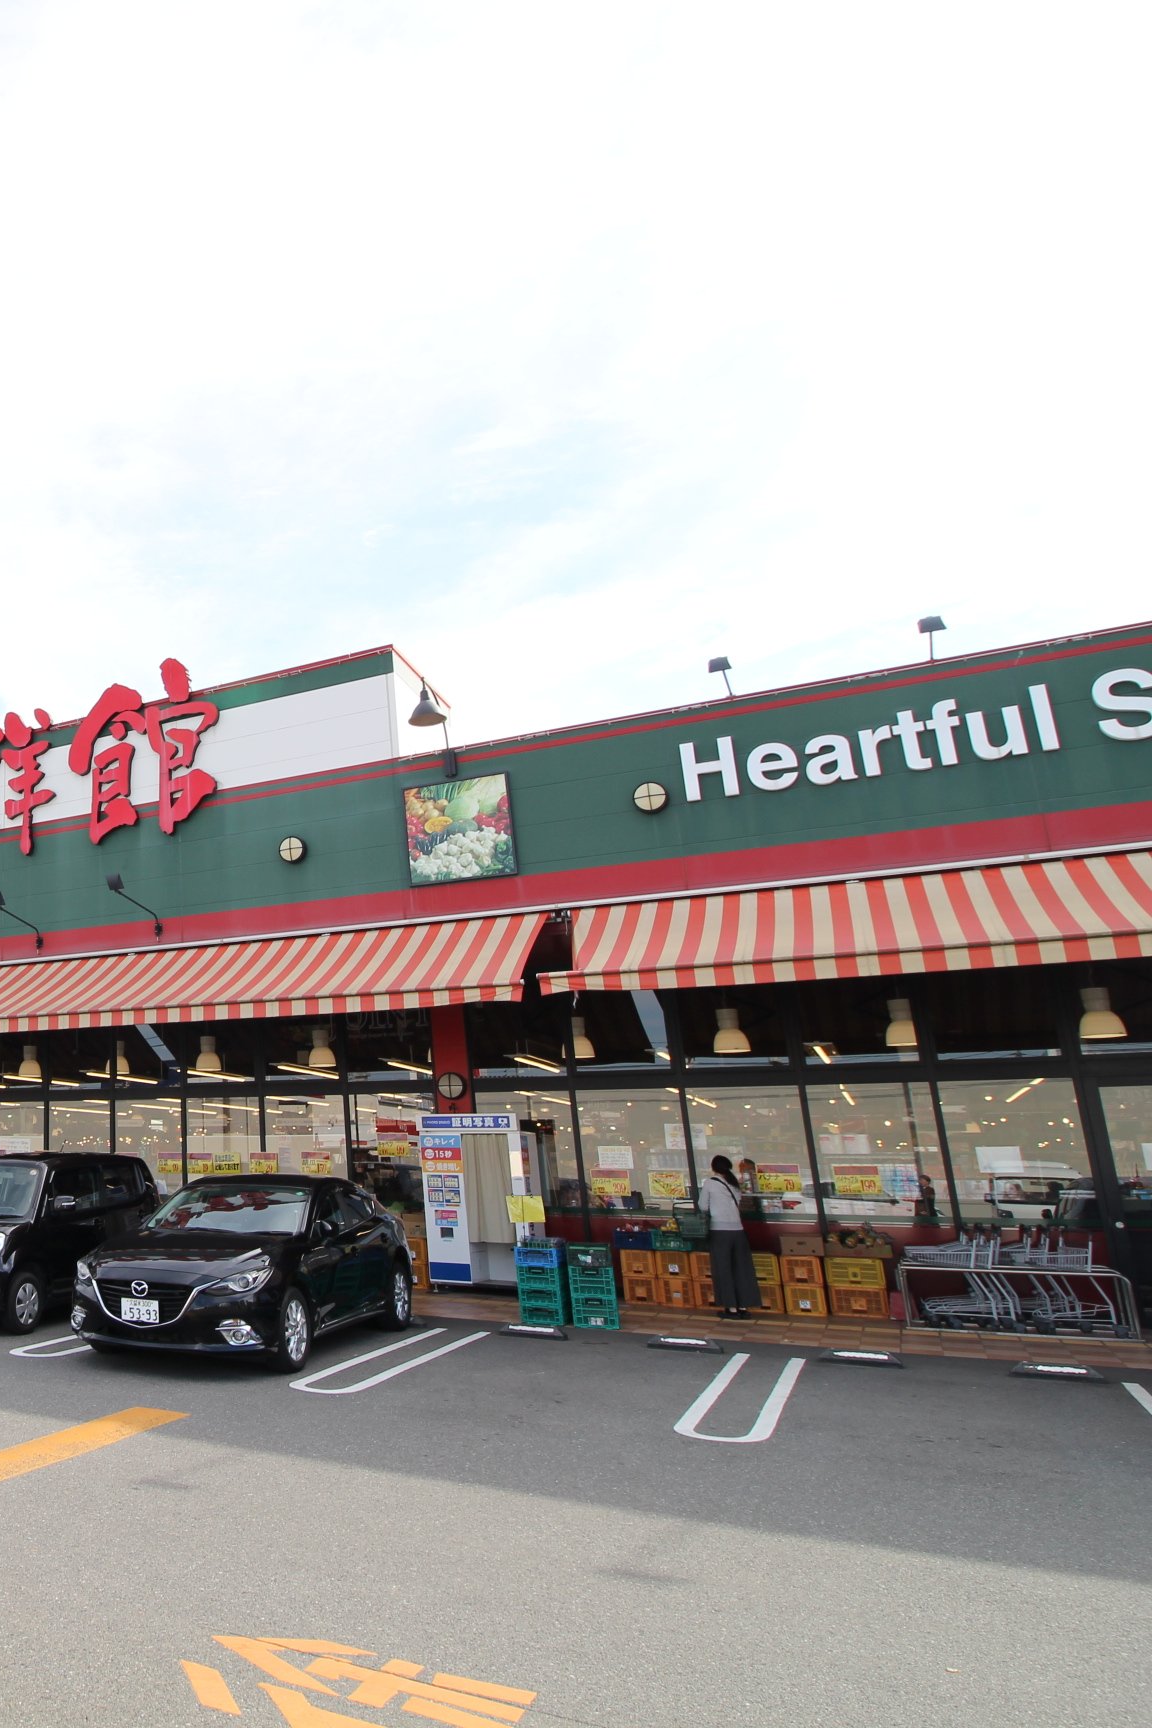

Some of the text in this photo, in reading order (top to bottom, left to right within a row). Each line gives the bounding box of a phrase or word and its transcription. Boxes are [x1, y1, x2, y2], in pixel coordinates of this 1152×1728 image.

[679, 684, 1061, 802] Heartful
[452, 1117, 494, 1127] 証明写真
[434, 1138, 455, 1146] キレイ
[435, 1150, 452, 1158] 15秒
[783, 1179, 795, 1191] 79
[128, 1306, 158, 1321] 53-93
